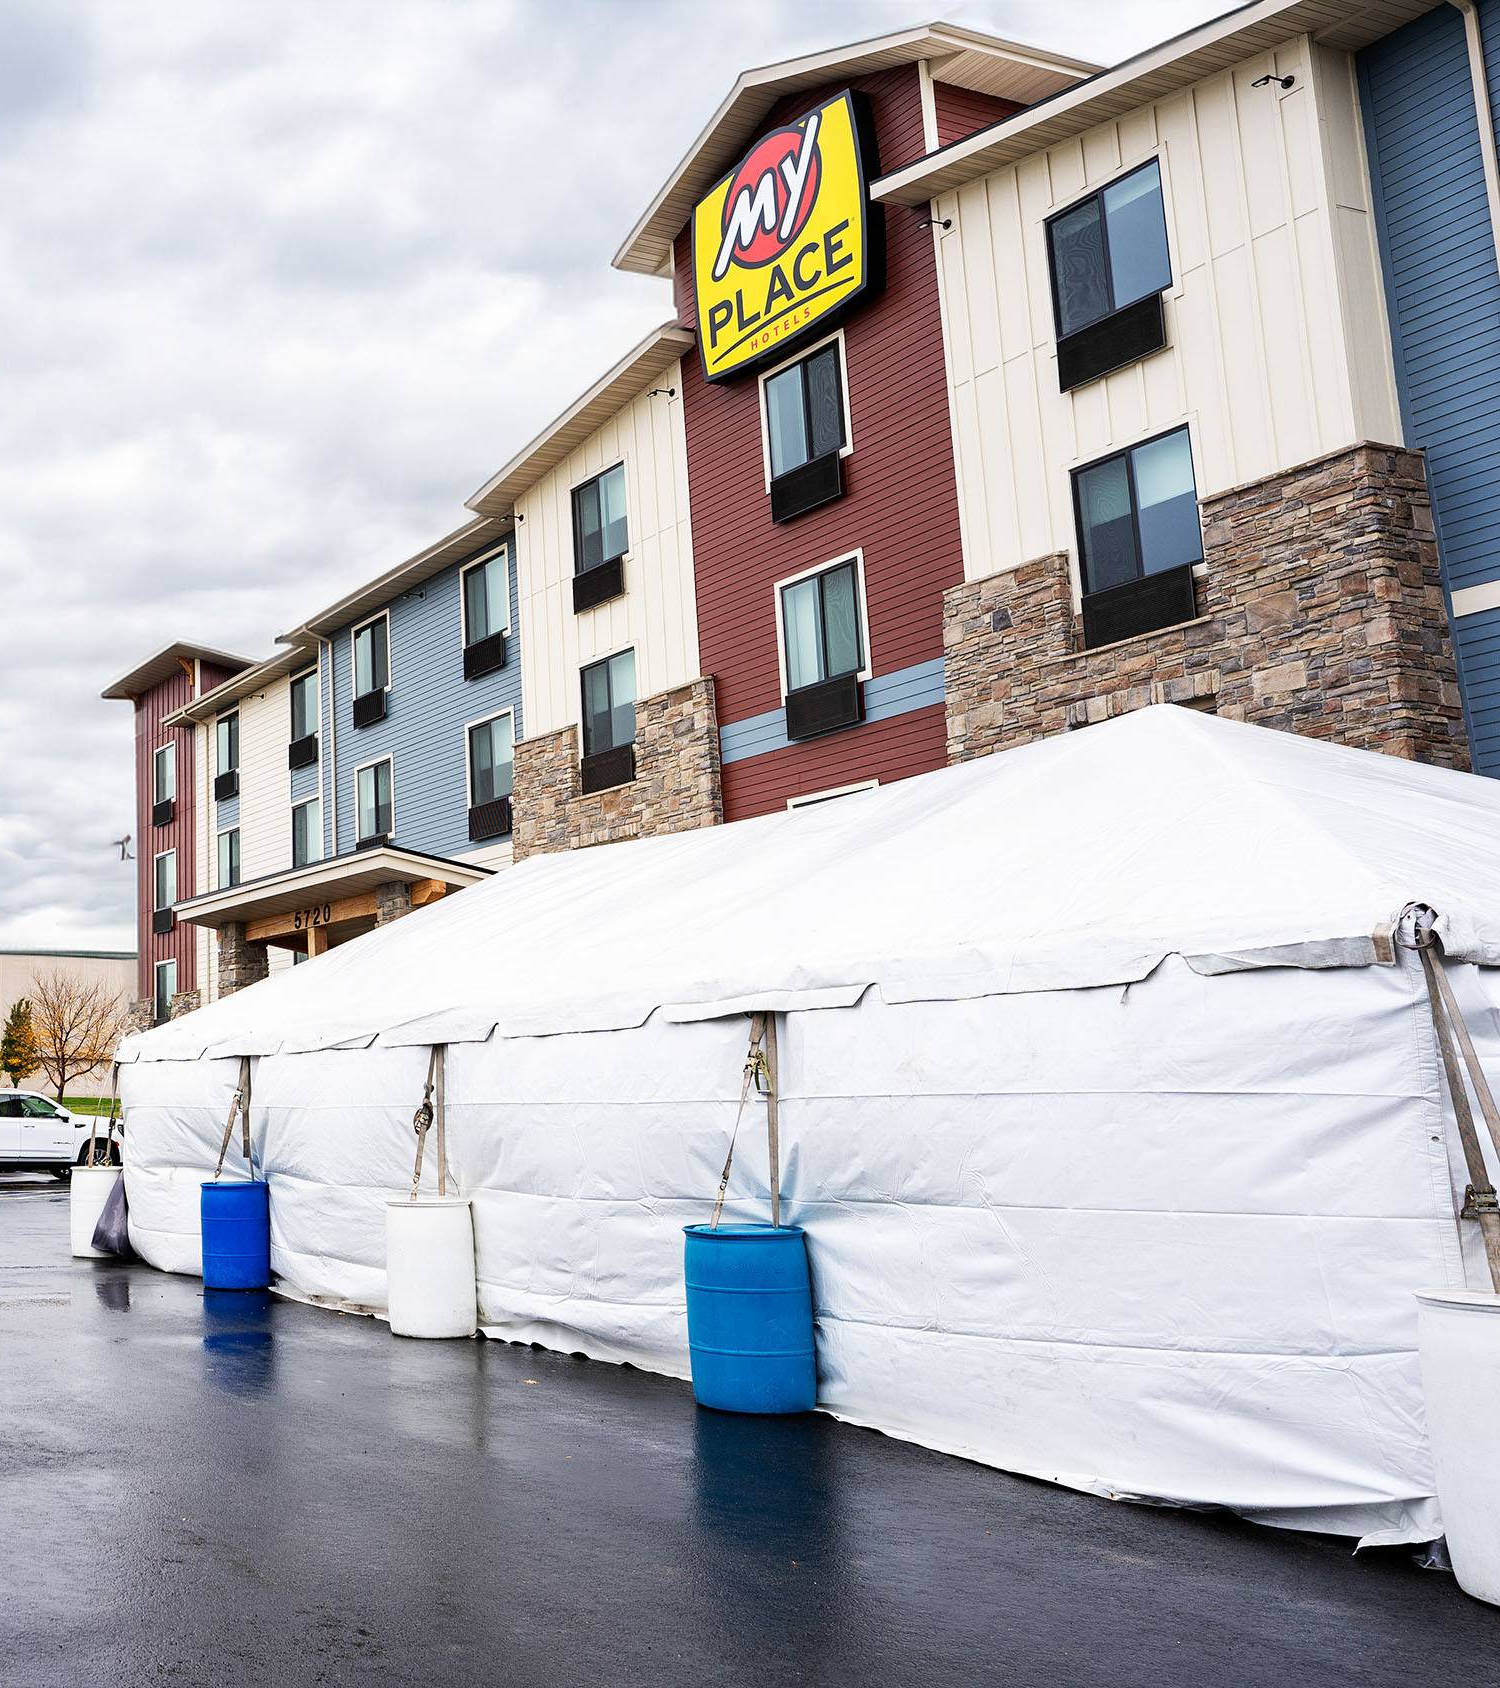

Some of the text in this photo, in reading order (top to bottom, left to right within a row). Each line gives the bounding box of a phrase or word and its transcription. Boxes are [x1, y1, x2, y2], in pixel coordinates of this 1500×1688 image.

[708, 218, 853, 349] PLACE
[750, 306, 811, 351] HOTELS
[294, 903, 331, 929] 5720
